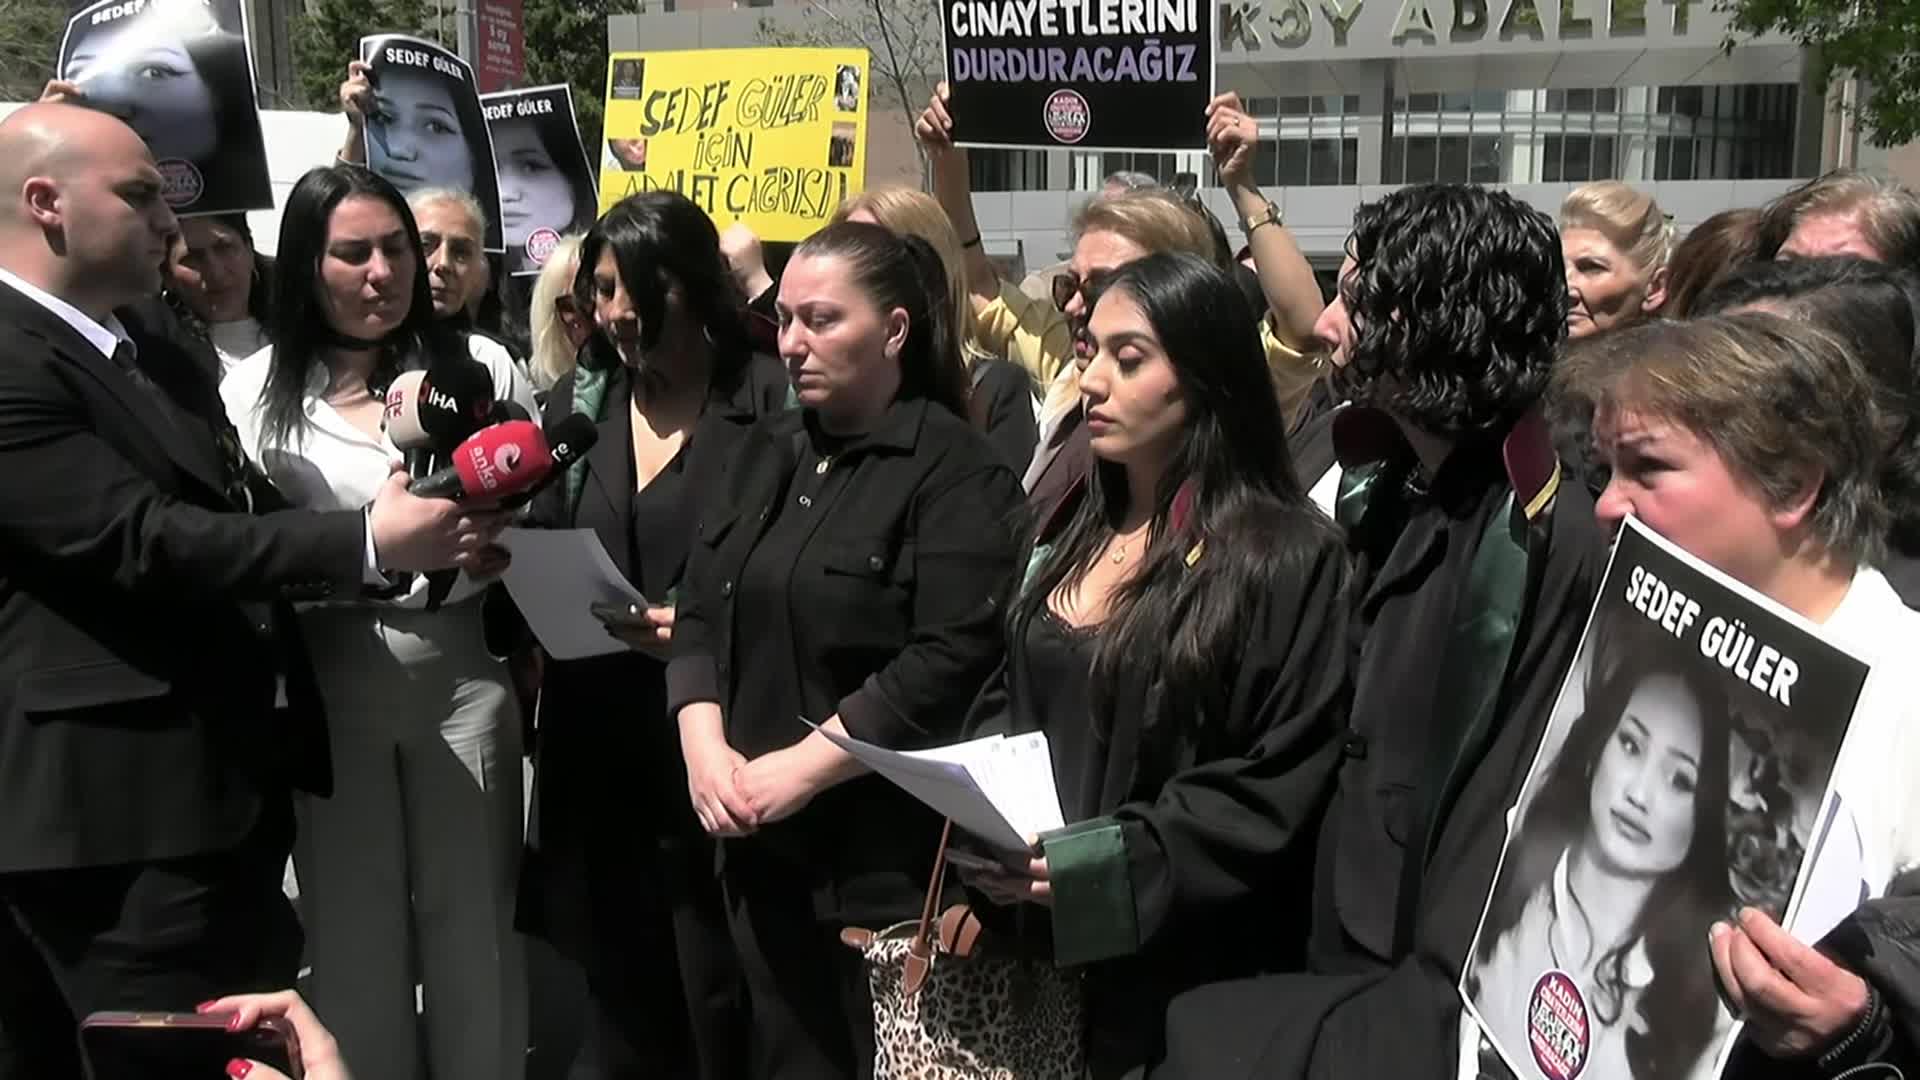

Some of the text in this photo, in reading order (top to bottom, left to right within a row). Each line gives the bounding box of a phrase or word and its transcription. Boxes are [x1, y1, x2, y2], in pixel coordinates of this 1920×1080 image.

[386, 47, 430, 68] SEDEF
[432, 56, 465, 81] GÜLER
[953, 38, 1198, 83] DURDURACAĞIZ
[482, 98, 553, 121] SEDEF GÜLER
[640, 74, 829, 137] SEDEF GÜLER
[1625, 565, 1800, 706] SEDEF GÜLER
